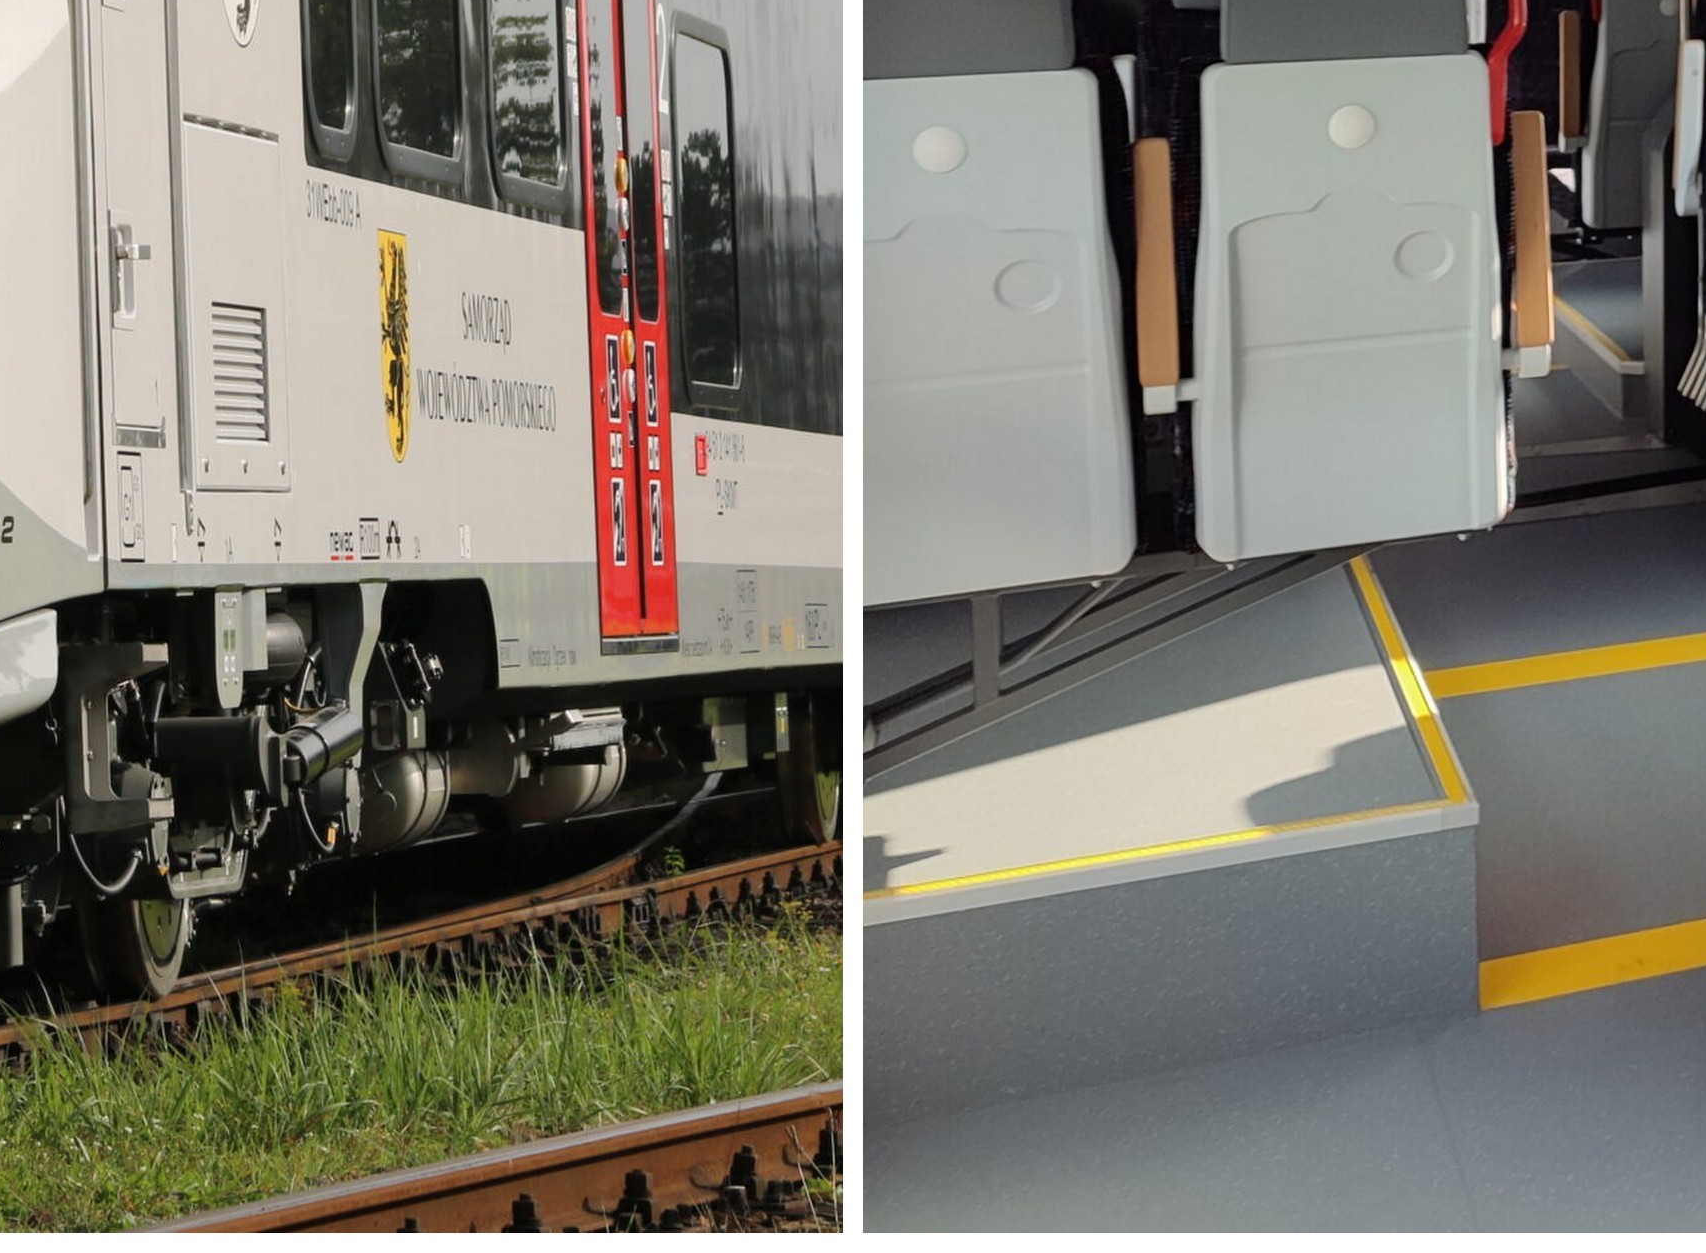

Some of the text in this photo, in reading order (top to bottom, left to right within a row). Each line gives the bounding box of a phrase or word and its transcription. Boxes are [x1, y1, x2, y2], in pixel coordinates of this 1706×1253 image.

[656, 2, 669, 115] 2
[306, 179, 362, 229] 31WEbb-009 A
[460, 291, 513, 354] SAMORZĄD
[416, 362, 557, 432] WOJEWÓDZTWA POMORSKIEGO
